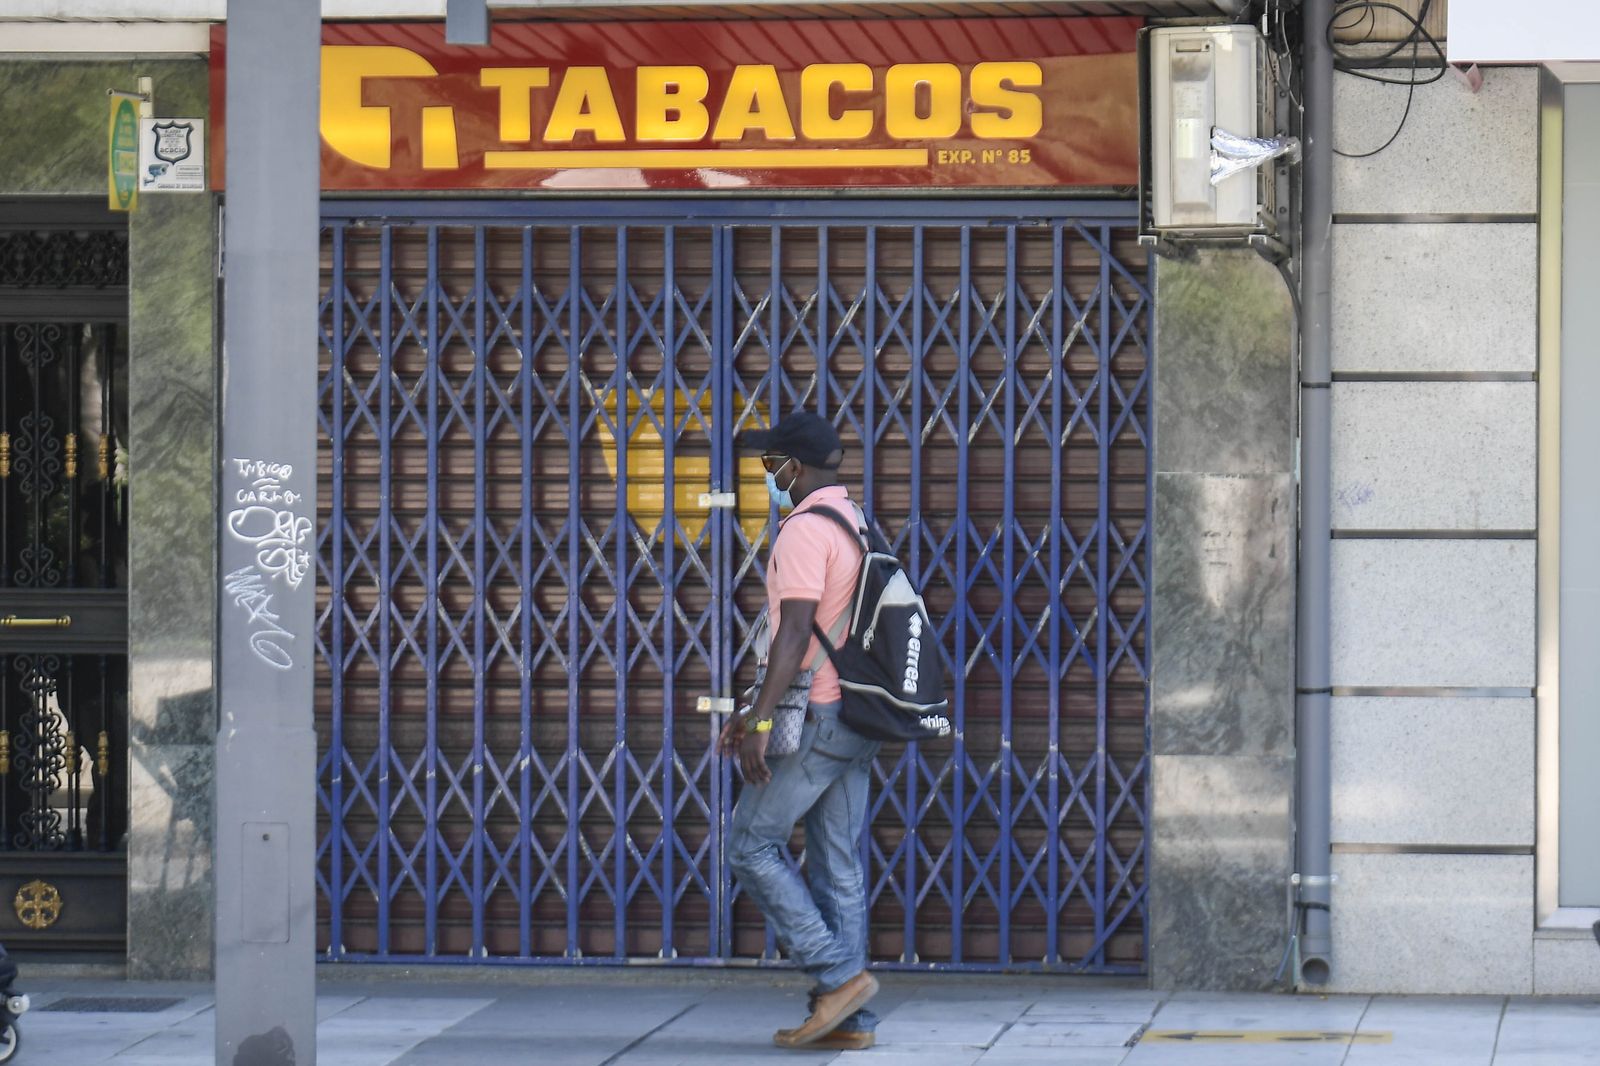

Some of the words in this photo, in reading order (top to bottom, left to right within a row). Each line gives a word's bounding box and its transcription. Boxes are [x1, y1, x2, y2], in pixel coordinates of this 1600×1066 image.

[480, 62, 1043, 142] TABACOS
[937, 149, 976, 165] EXP.
[1008, 149, 1031, 164] 85
